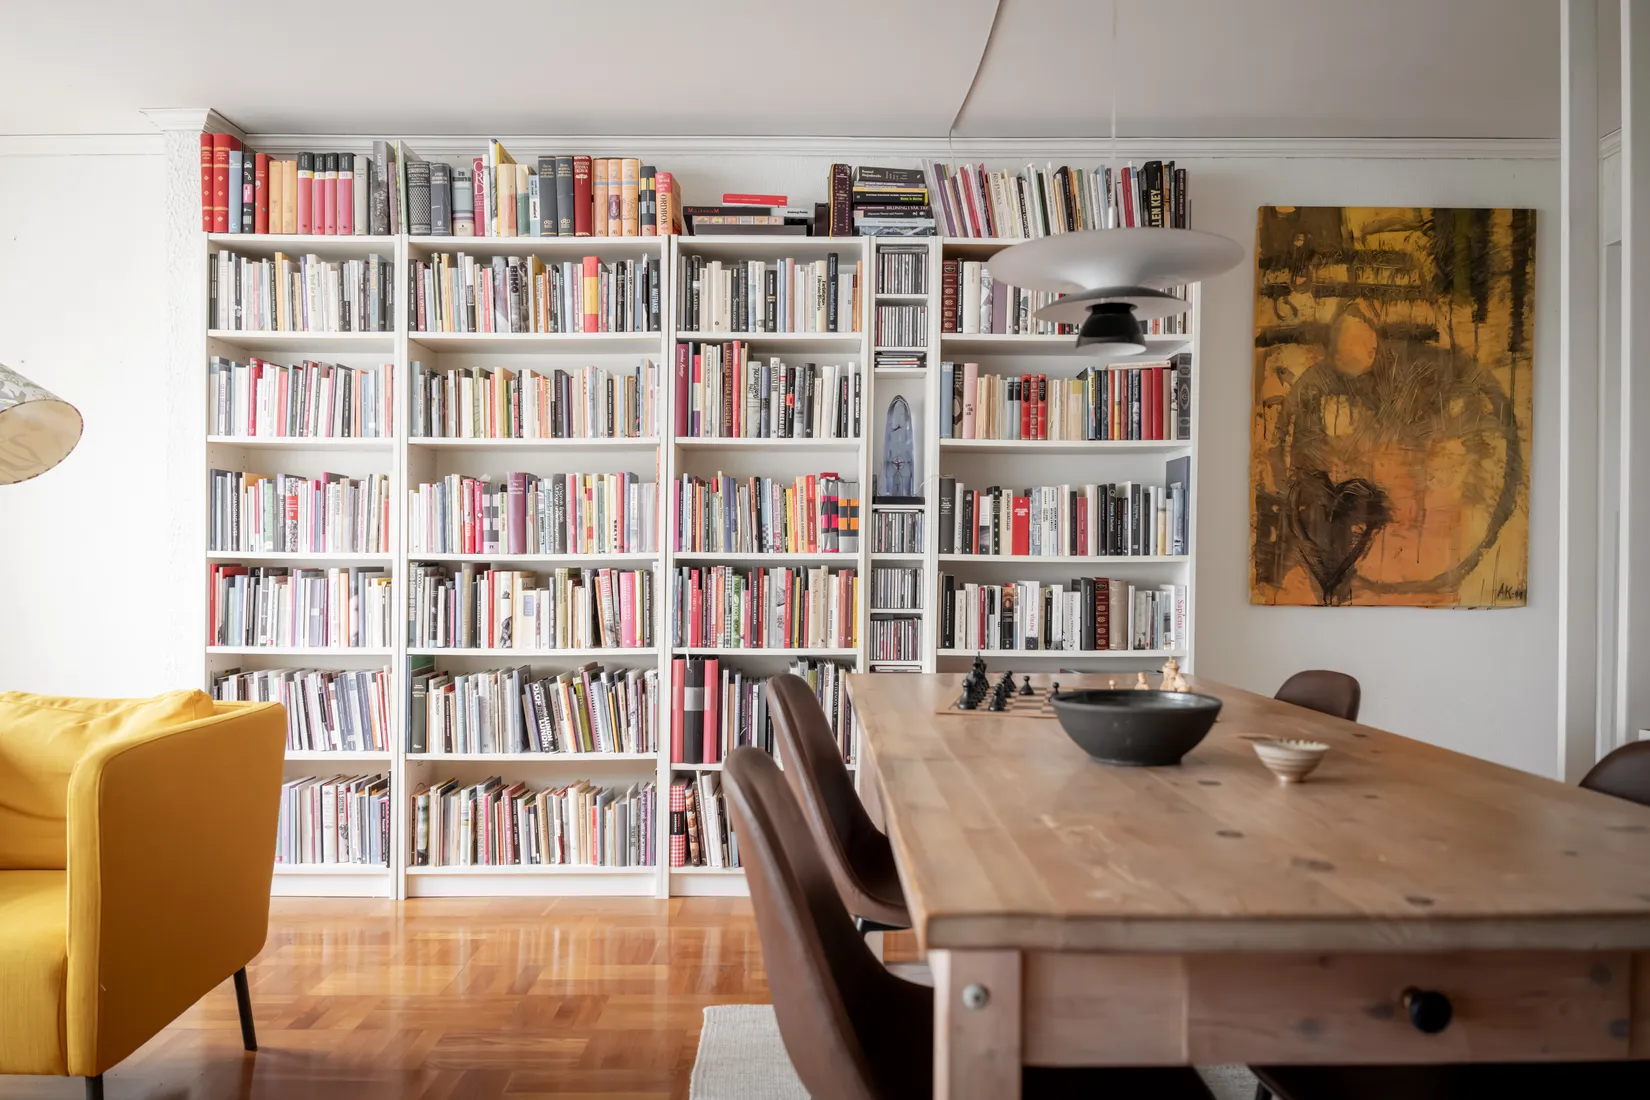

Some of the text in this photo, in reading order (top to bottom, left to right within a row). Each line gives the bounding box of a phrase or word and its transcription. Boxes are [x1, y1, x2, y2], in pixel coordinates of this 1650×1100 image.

[660, 194, 668, 225] ORDBOK
[1150, 190, 1161, 206] KEY
[510, 265, 519, 294] BIKO
[1175, 599, 1184, 629] Sapiens
[533, 684, 541, 706] OLOF
[539, 719, 549, 748] LUNDH
[543, 717, 553, 742] LUNDH
